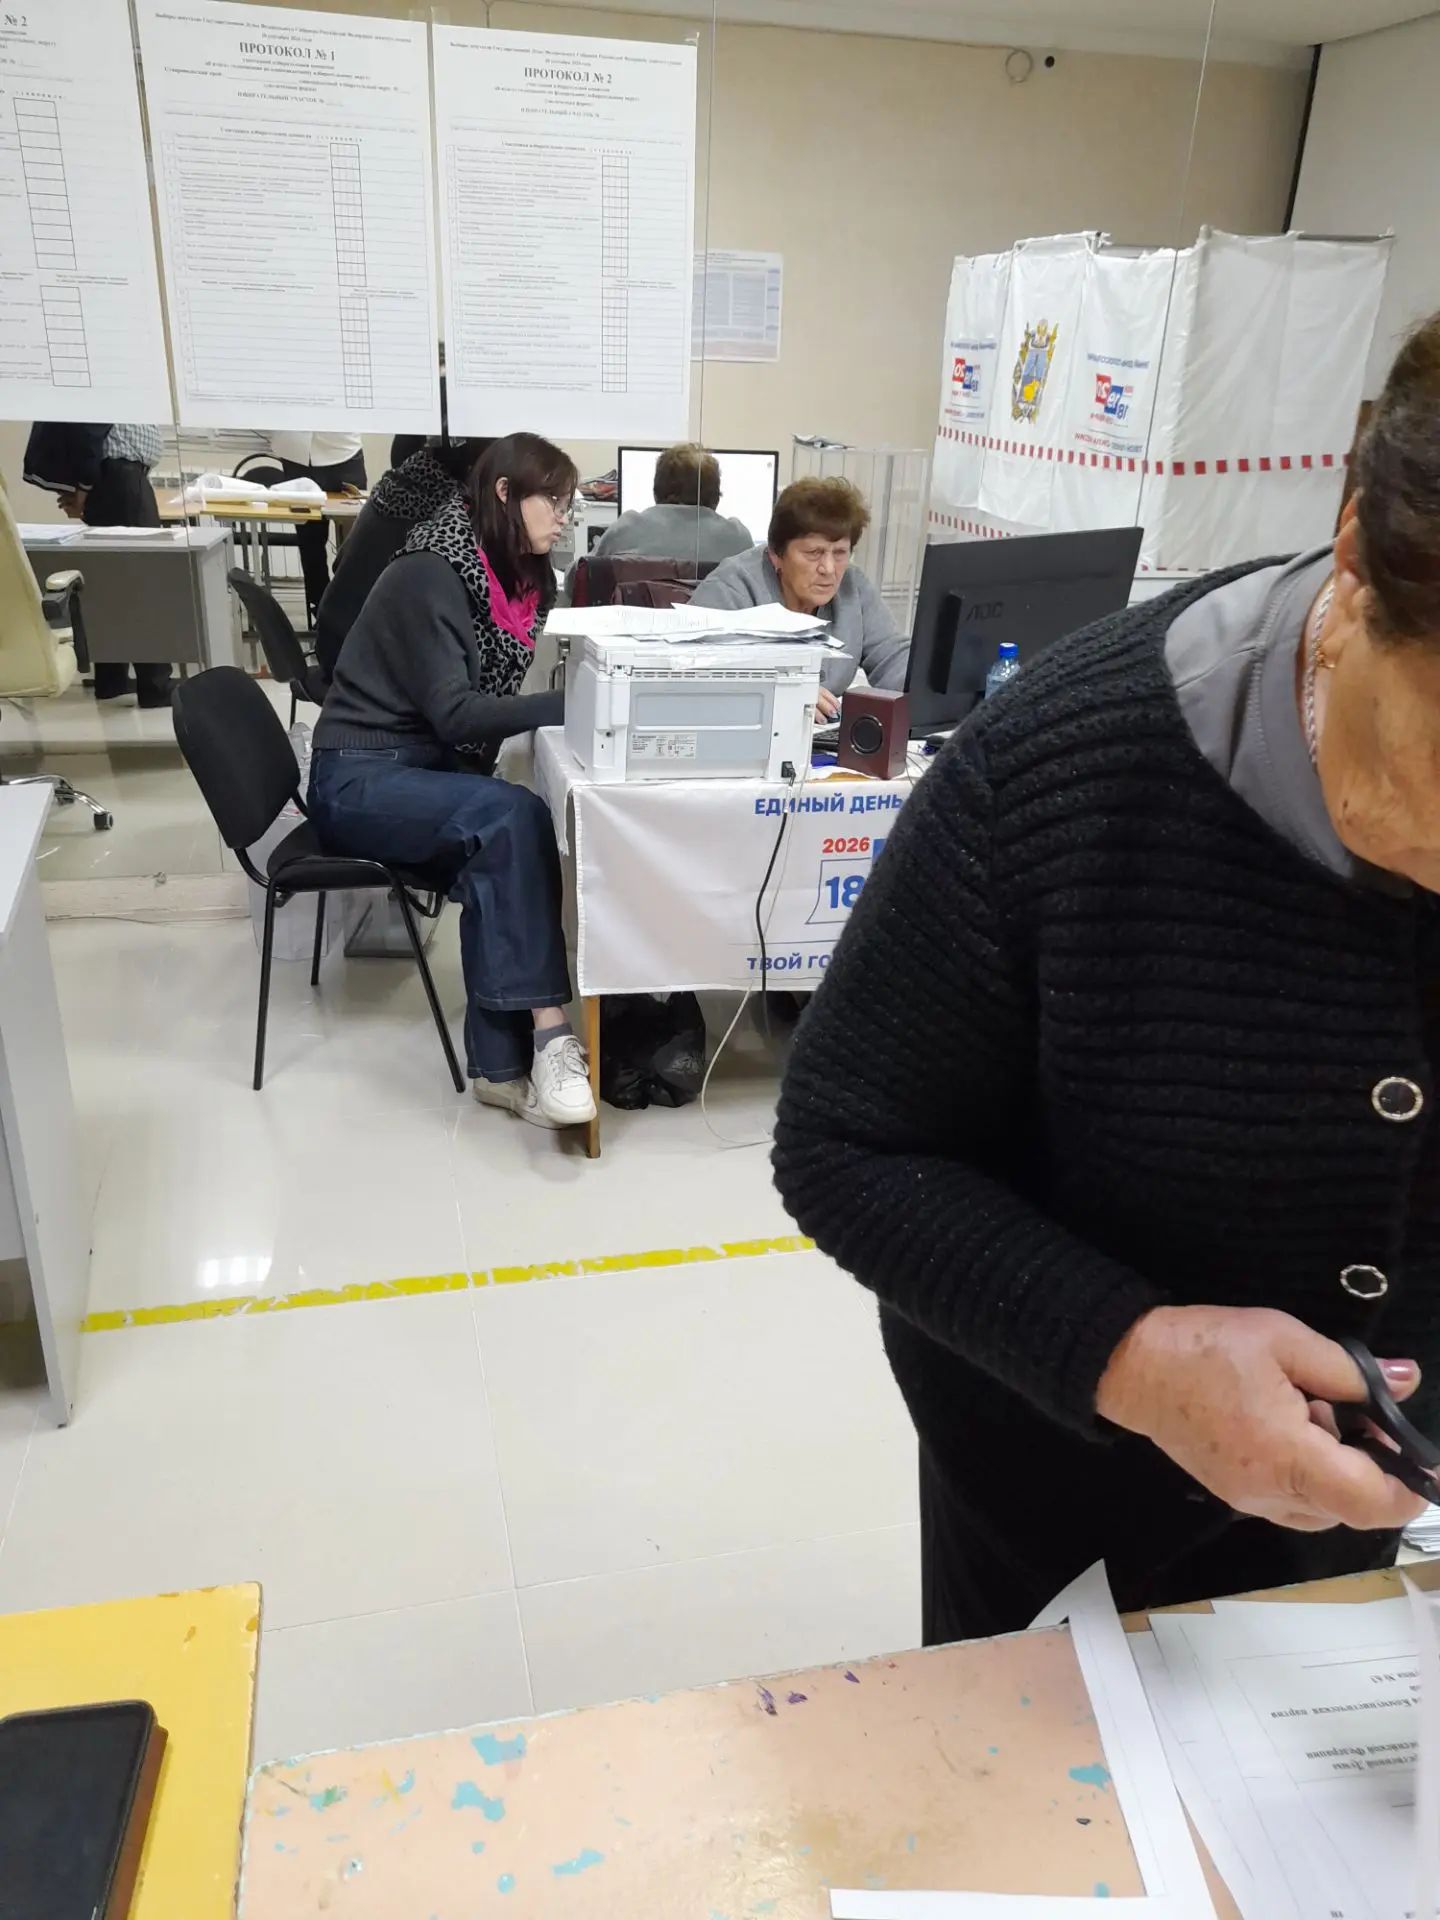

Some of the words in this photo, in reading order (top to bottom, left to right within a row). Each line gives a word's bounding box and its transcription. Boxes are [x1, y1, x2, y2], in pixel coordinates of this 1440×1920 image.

[4, 14, 18, 27] №
[21, 15, 28, 27] 2
[239, 41, 312, 59] ПРОТОКОЛ
[314, 48, 328, 60] №
[524, 66, 590, 83] ПРОТОКОЛ
[592, 72, 605, 84] №
[607, 73, 613, 84] 2
[966, 601, 1004, 621] AOC
[755, 793, 844, 816] ЕДИНЫЙ
[849, 794, 904, 814] ДЕНЬ
[822, 837, 870, 853] 2026
[825, 875, 865, 908] 18
[747, 953, 802, 970] ТВОЙ
[807, 955, 832, 969] ГО
